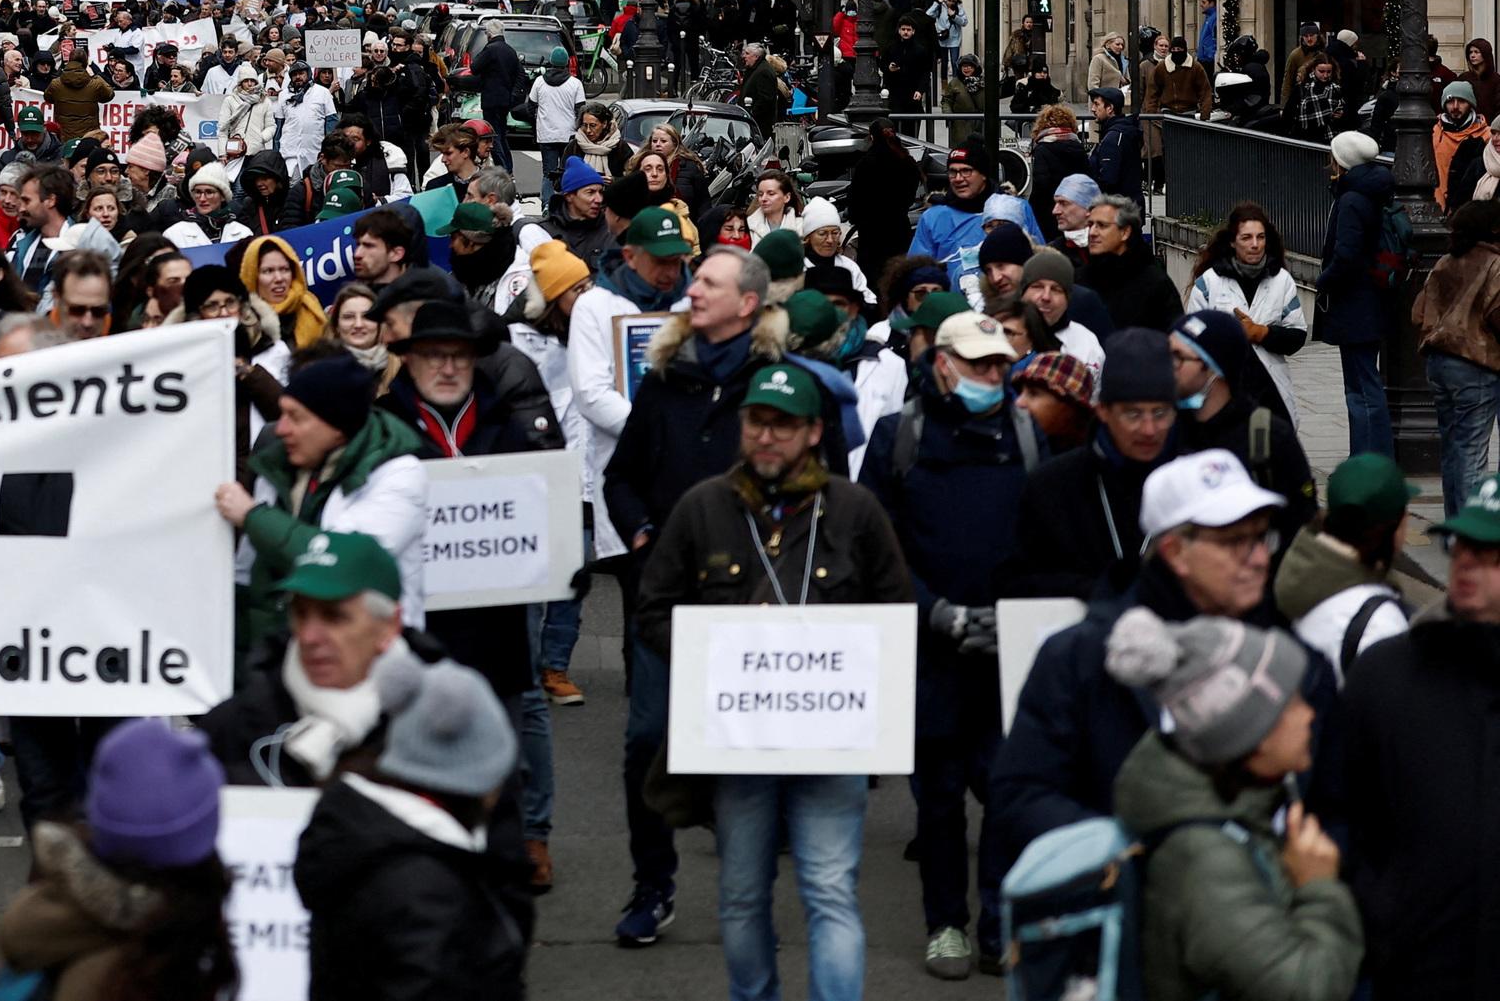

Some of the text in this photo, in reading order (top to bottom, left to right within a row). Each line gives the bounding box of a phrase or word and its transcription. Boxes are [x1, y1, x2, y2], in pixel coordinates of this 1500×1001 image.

[313, 35, 358, 46] GYNECO
[424, 499, 517, 526] FATOME
[419, 534, 539, 564] EMISSION
[741, 650, 845, 674] FATOME
[716, 690, 867, 714] DEMISSION
[228, 863, 295, 892] FAT
